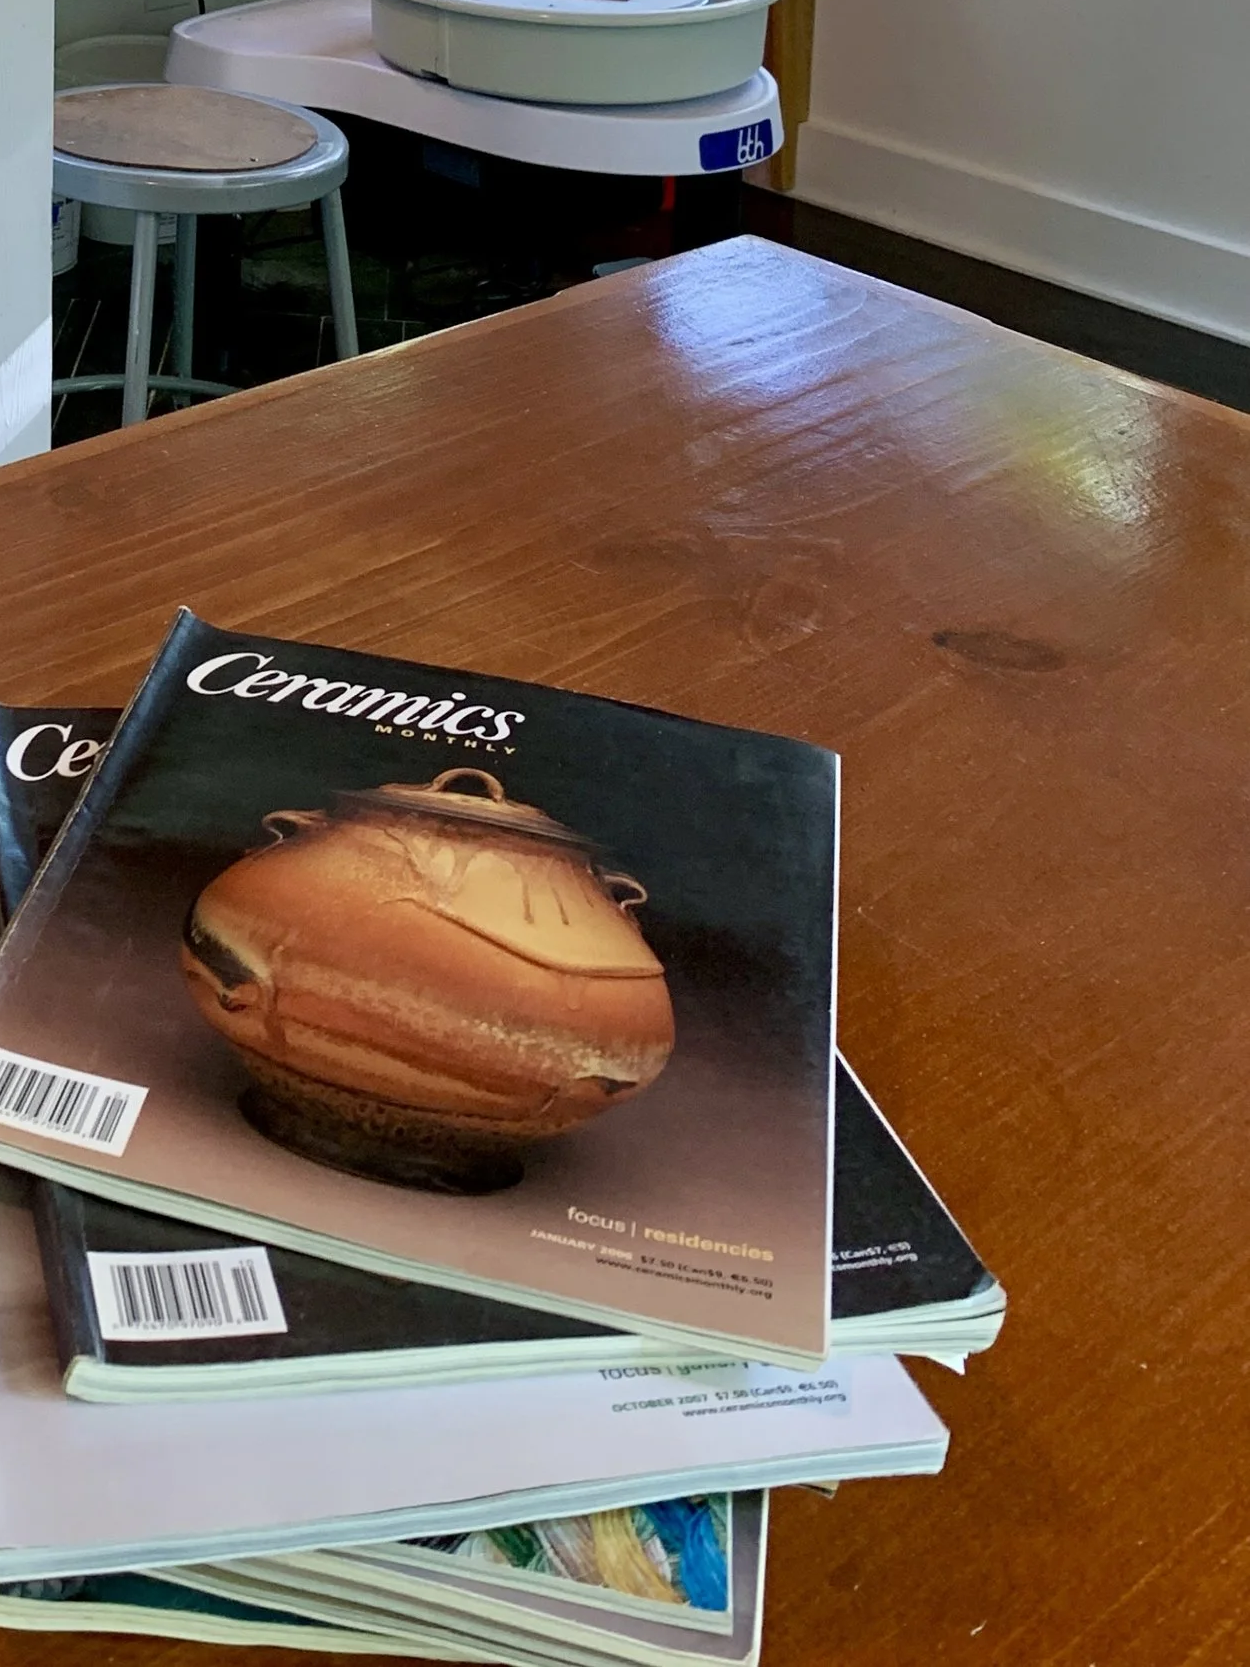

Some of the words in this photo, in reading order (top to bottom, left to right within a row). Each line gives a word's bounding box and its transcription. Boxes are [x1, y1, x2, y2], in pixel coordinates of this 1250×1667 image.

[187, 652, 526, 741] Ceramics
[374, 723, 517, 755] MONTHLY
[529, 1228, 596, 1251] JANUARY
[566, 1205, 627, 1234] focus
[644, 1226, 775, 1263] residencies
[595, 1256, 773, 1301] www.ceramicsmonthly.org
[611, 1398, 675, 1414] OCTOBER
[682, 1392, 848, 1418] www.ceramicsmonthly.org
